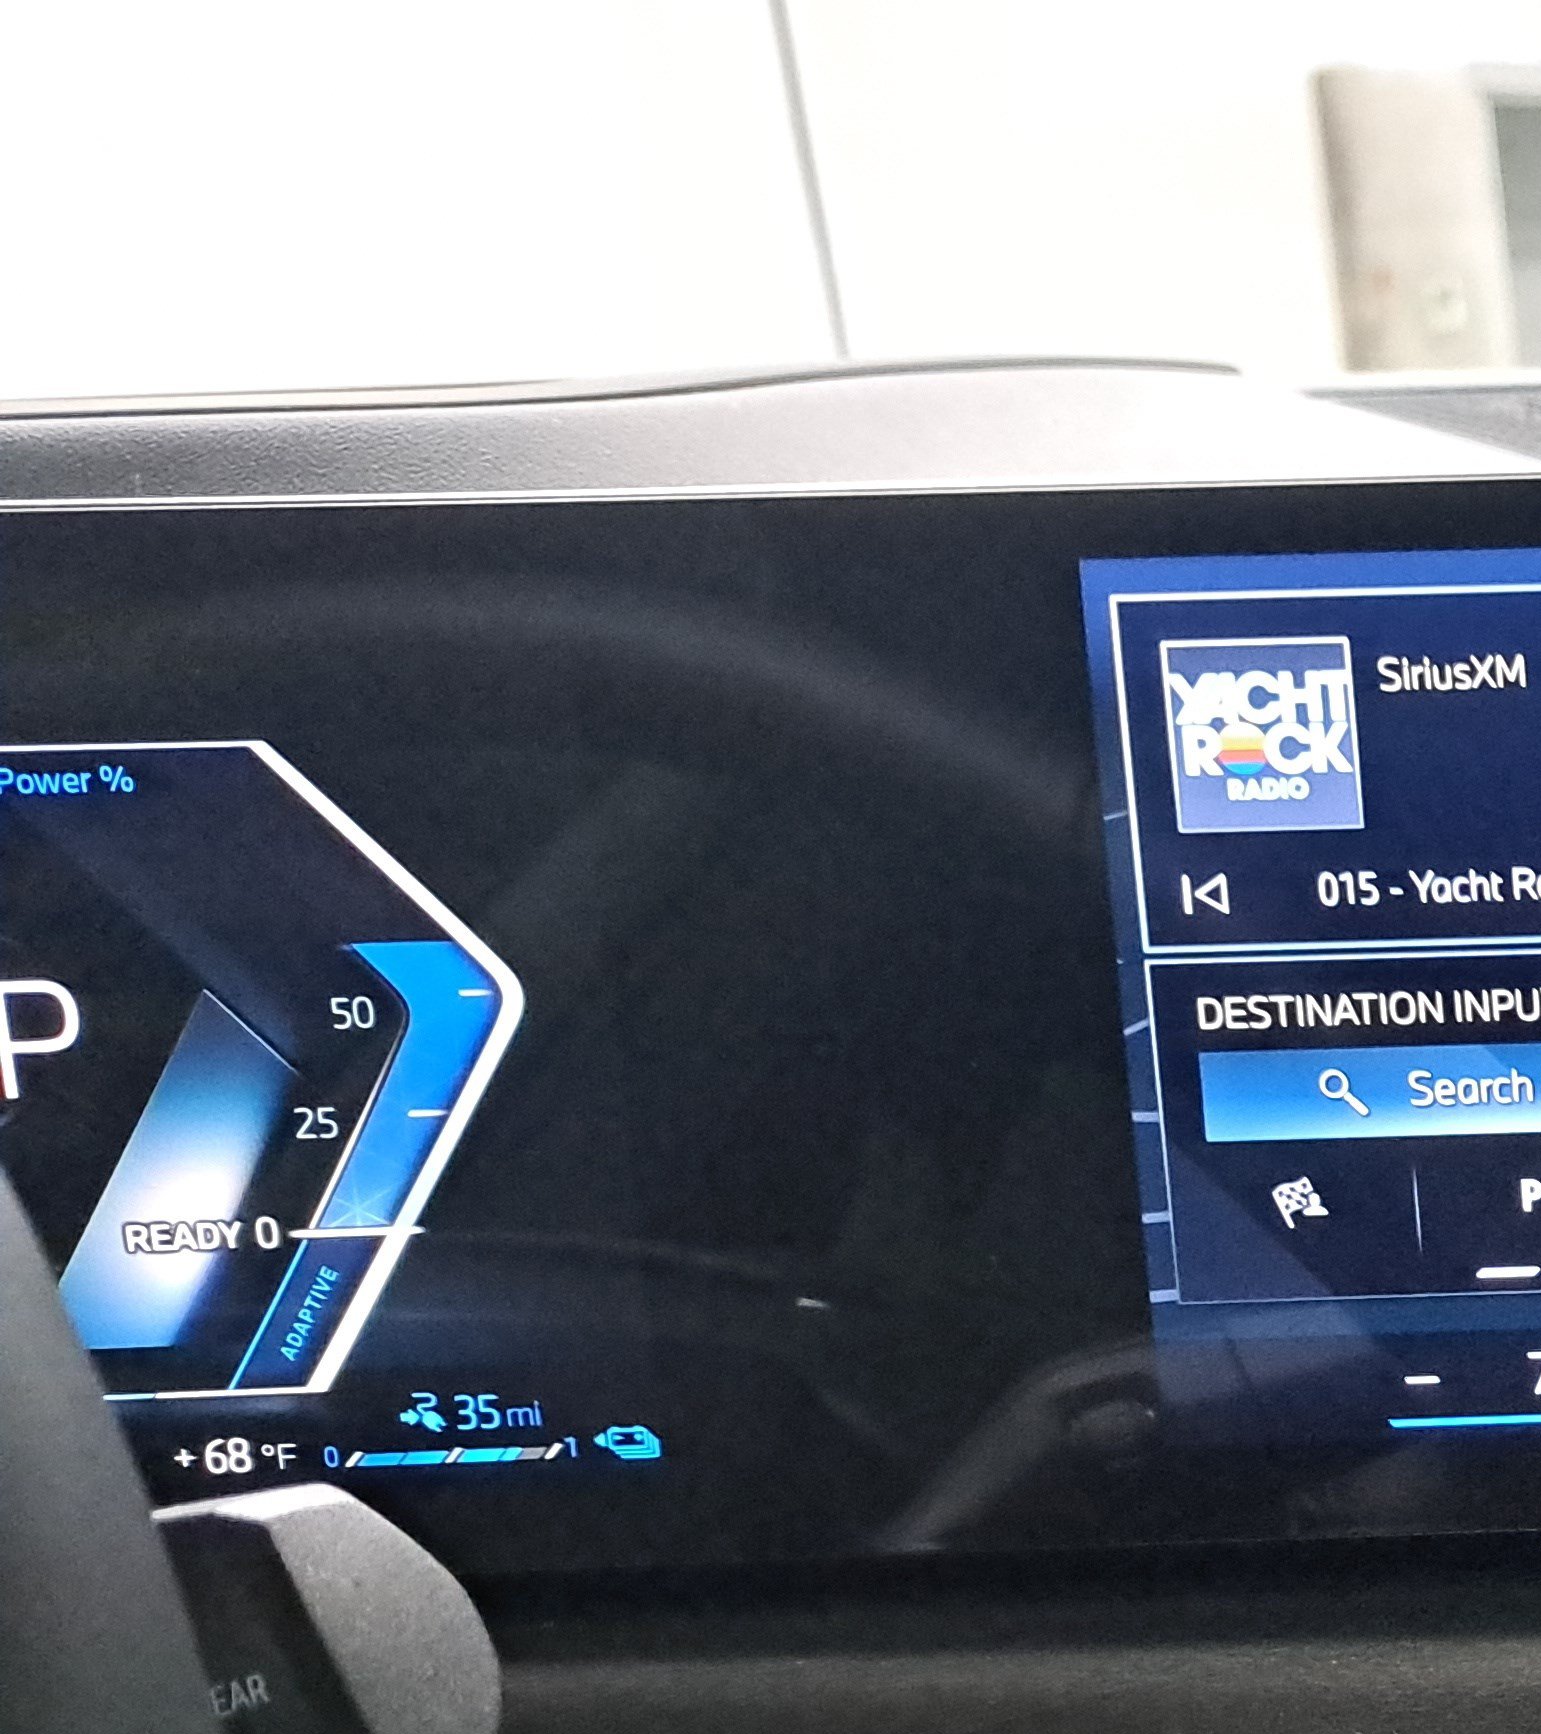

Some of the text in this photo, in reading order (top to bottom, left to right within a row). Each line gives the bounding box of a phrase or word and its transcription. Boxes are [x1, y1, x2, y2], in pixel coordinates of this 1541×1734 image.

[1377, 654, 1527, 692] SiriusXM
[1169, 670, 1347, 725] YACHT
[1181, 721, 1353, 776] ROCK
[0, 765, 135, 795] Power %
[1226, 776, 1310, 801] RADIO
[1317, 871, 1380, 907] 015
[1409, 867, 1503, 904] Yacht
[330, 996, 375, 1030] 50
[1197, 989, 1446, 1030] DESTINATION
[0, 979, 80, 1099] P
[1408, 1066, 1534, 1107] Search
[293, 1106, 339, 1139] 25
[124, 1216, 280, 1253] READY 0
[280, 1264, 340, 1361] ADAPTIVE
[453, 1394, 543, 1431] 35 mi
[323, 1446, 340, 1469] 0
[564, 1437, 578, 1457] 1
